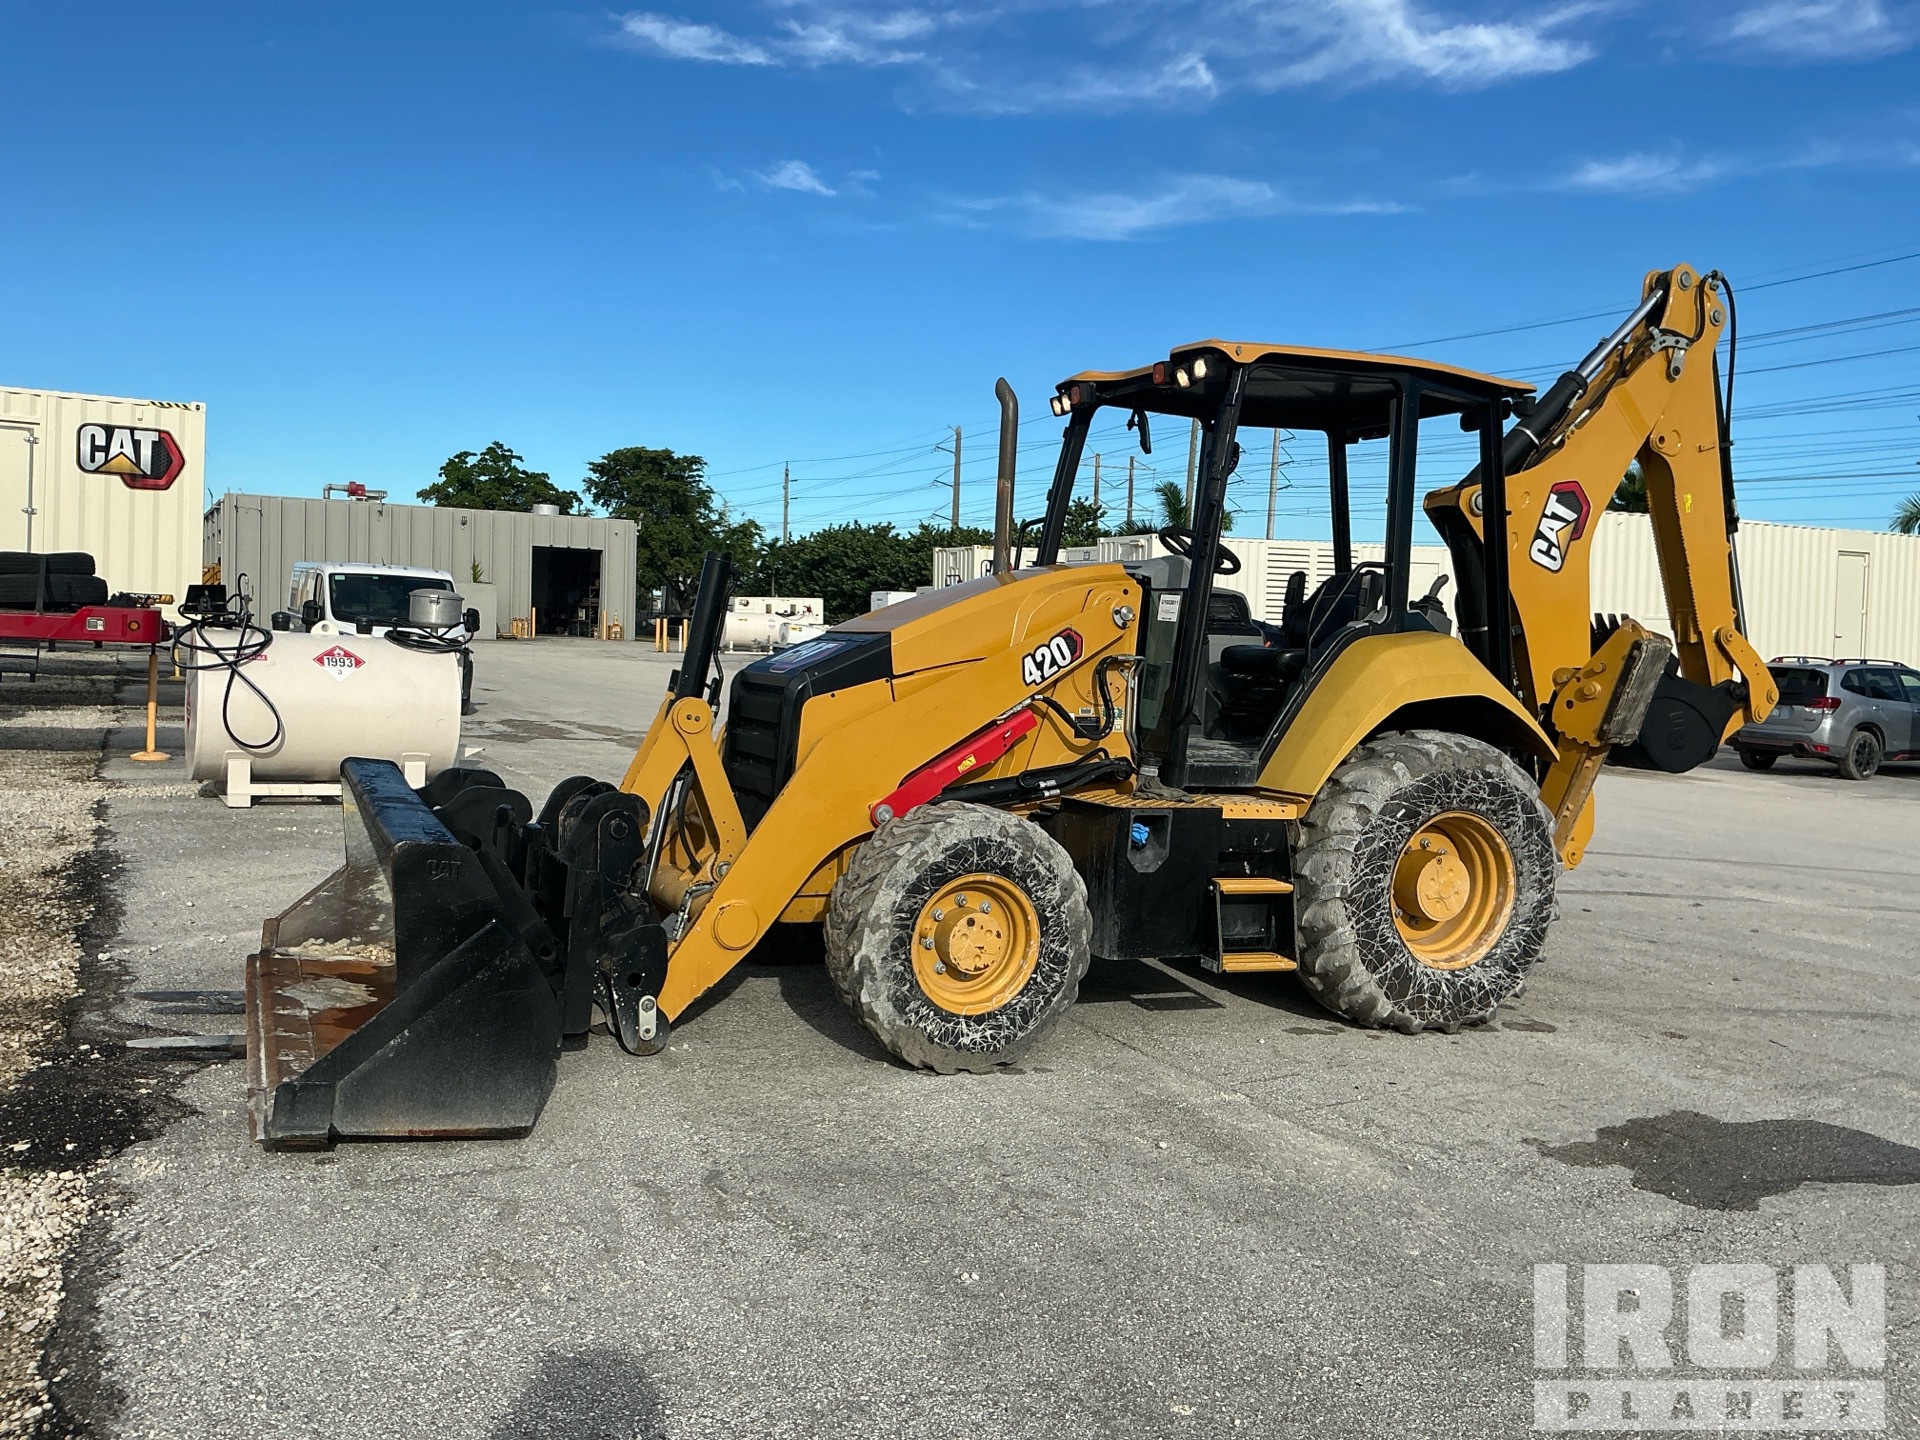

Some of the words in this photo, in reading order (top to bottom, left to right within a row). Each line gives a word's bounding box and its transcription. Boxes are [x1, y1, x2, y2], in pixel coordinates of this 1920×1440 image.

[80, 425, 159, 475] CAT
[1530, 492, 1579, 571] CAT
[325, 656, 354, 668] 1993
[1023, 636, 1072, 685] 420
